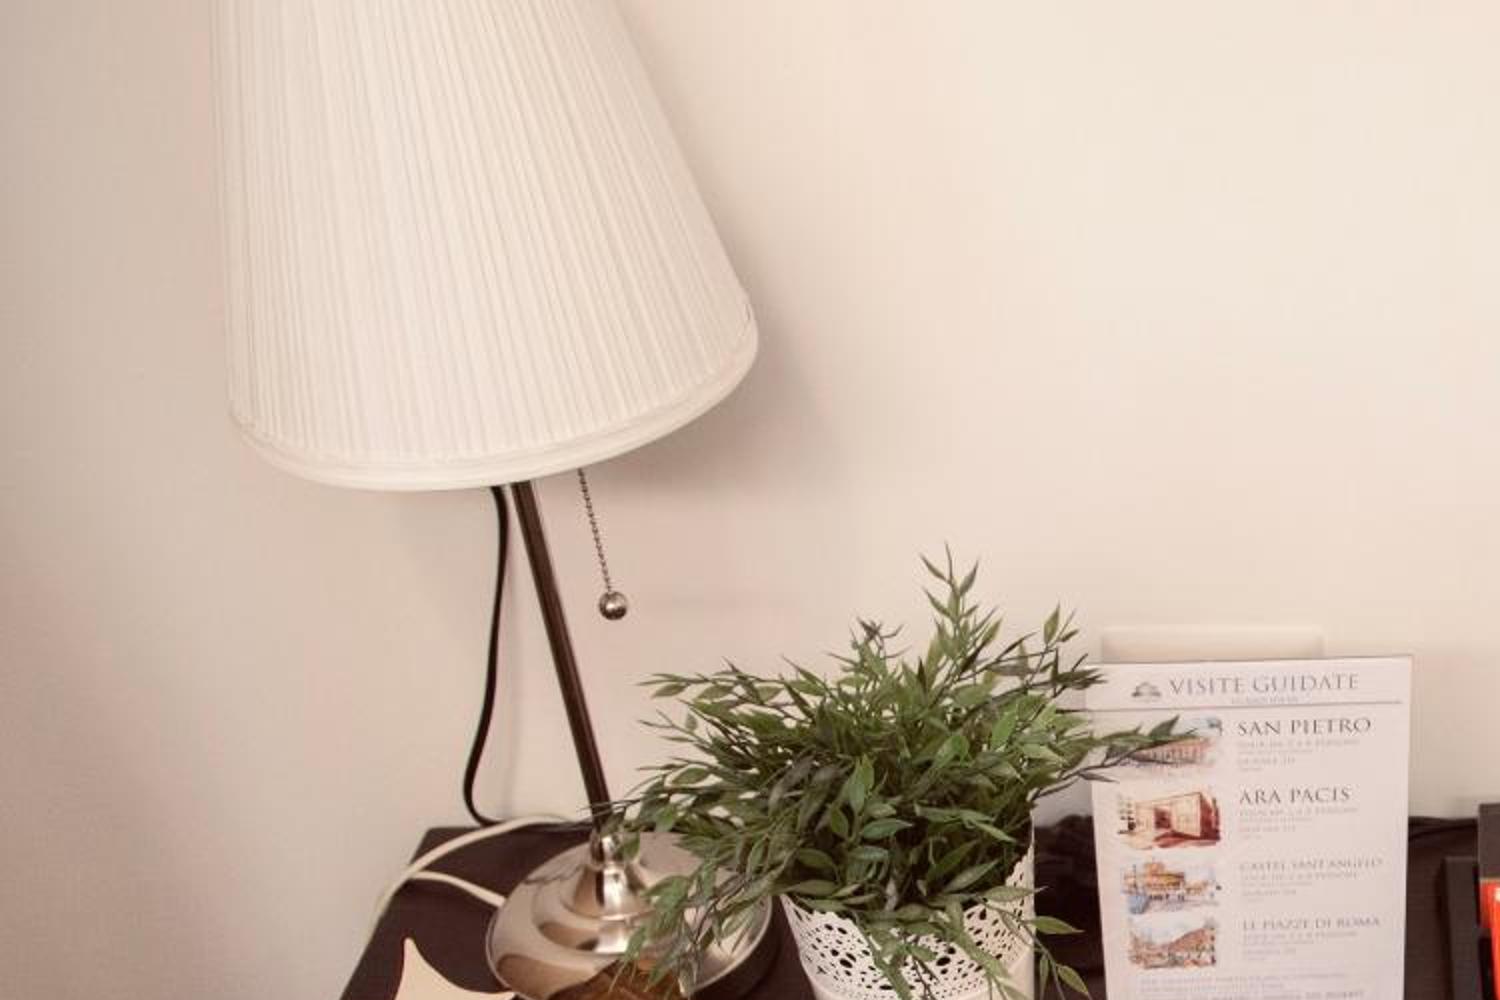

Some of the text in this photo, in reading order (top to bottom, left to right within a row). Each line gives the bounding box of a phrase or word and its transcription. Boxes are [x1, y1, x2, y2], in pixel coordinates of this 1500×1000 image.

[1169, 673, 1360, 697] VISITE GUIDATE
[1238, 717, 1371, 736] SAN PIETRO
[1239, 786, 1351, 805] ARA PACIS
[1336, 915, 1381, 928] ROMA
